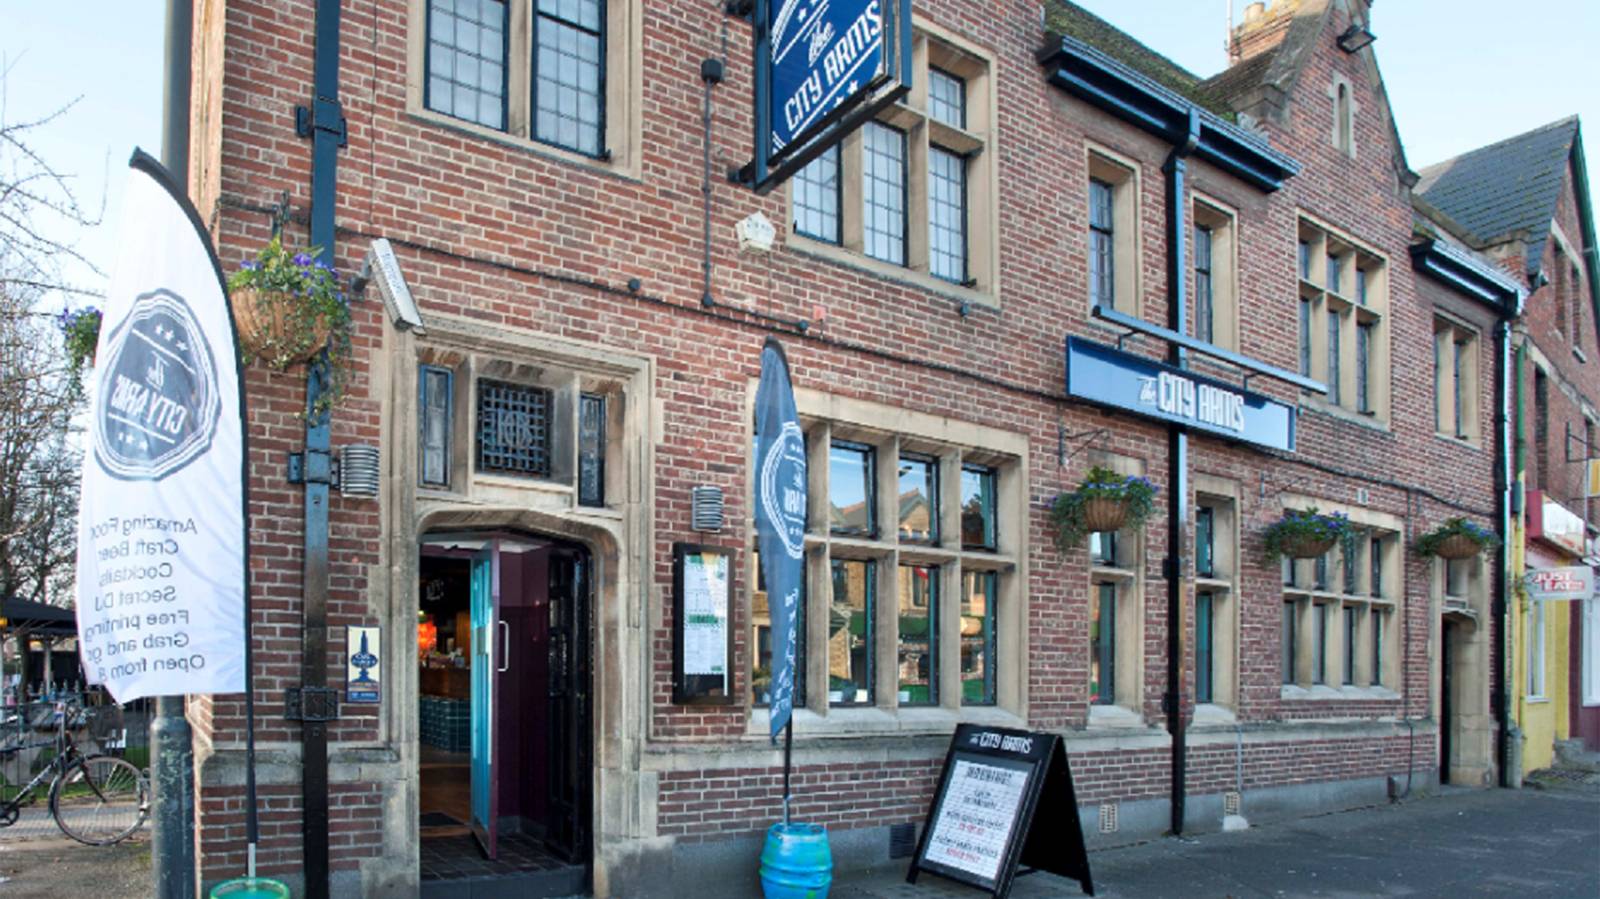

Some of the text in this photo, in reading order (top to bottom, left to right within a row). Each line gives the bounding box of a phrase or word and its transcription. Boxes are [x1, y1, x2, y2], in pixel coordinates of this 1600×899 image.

[784, 0, 882, 131] CITY ARMS
[1157, 371, 1196, 418] CITY
[1198, 384, 1245, 432] ARMS
[1531, 571, 1571, 584] JUST
[980, 732, 1001, 749] CITY
[1001, 735, 1033, 754] ARMS
